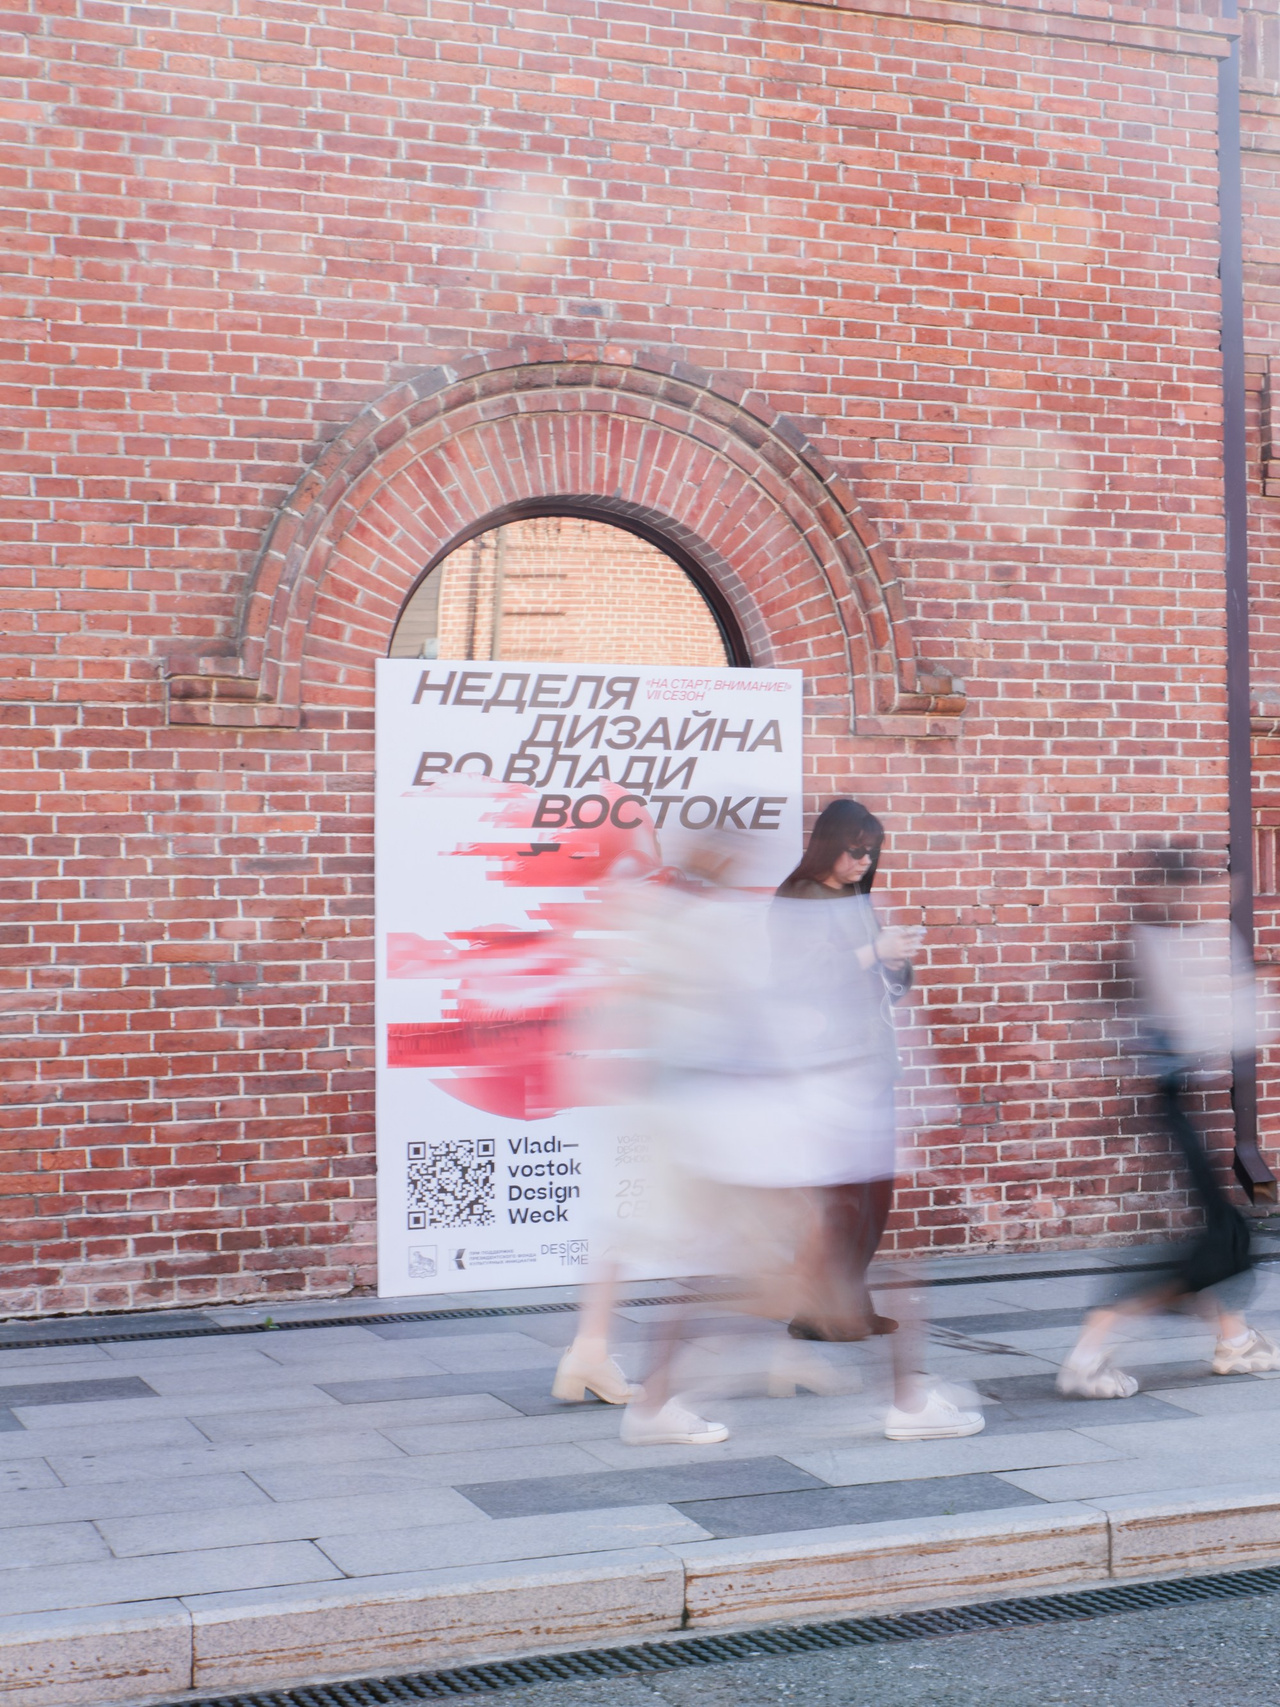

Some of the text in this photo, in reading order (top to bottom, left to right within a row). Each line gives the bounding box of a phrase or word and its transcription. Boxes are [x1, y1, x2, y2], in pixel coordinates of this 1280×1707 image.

[411, 670, 640, 714] НЕДЕЛЯ
[662, 690, 706, 701] СЕЗОН
[670, 679, 712, 691] СТАРТ,
[519, 710, 783, 753] ДИЗАЙНА
[412, 751, 698, 795] ВО ВЛАДИ
[532, 794, 788, 829] ВОСТОКЕ
[508, 1158, 582, 1178] vostok
[508, 1181, 580, 1203] Design
[508, 1204, 569, 1225] Week
[541, 1239, 588, 1255] DESIGN
[559, 1254, 589, 1266] TIME
